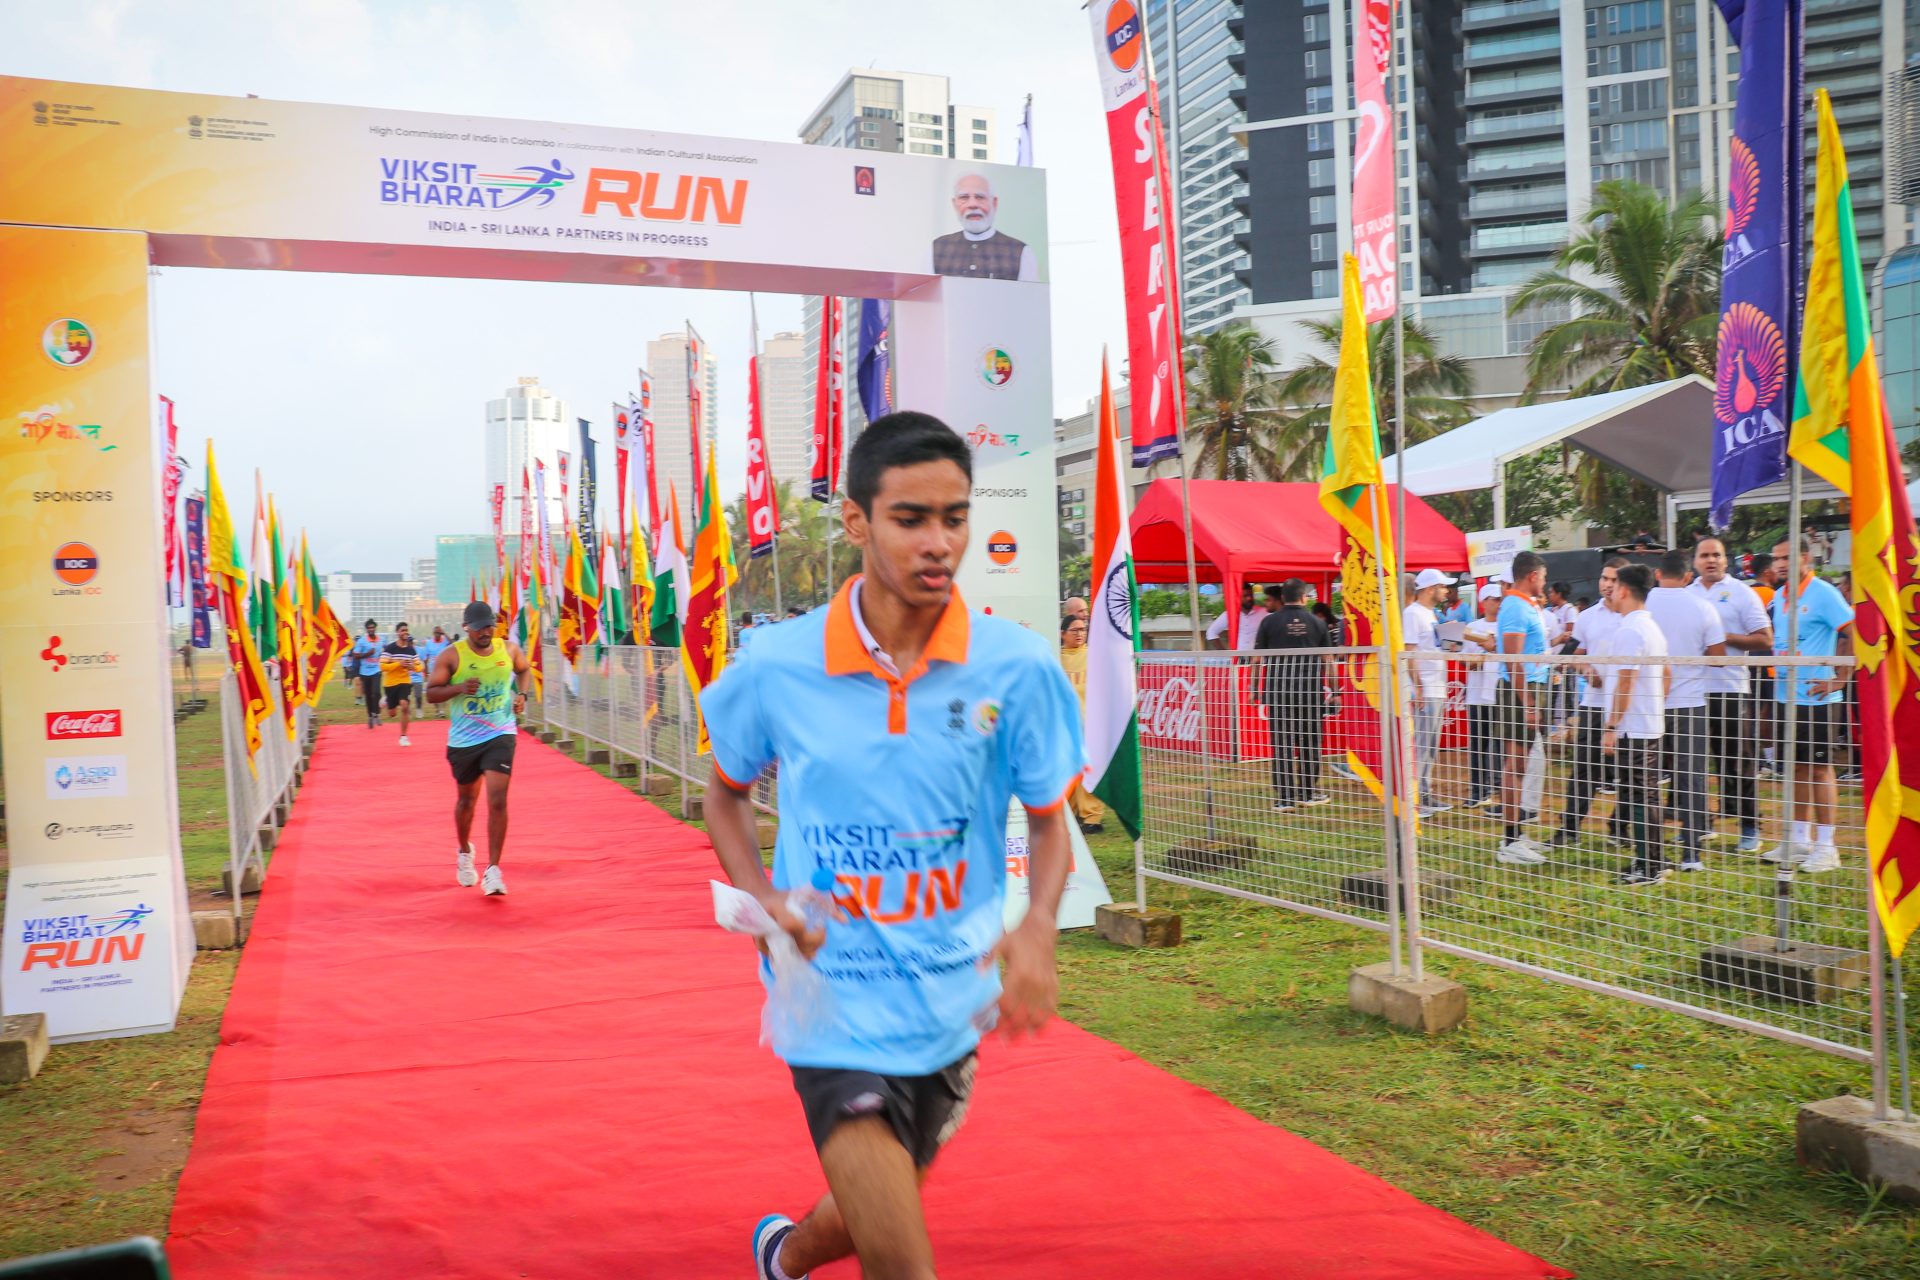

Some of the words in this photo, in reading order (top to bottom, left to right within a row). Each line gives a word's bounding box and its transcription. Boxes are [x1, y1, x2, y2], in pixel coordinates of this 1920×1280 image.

[1115, 24, 1133, 46] IOC
[369, 126, 393, 137] High
[395, 128, 459, 141] Commission
[460, 133, 471, 142] of
[472, 134, 498, 143] India
[499, 136, 509, 144] in
[511, 136, 555, 148] Colombo
[567, 142, 618, 153] collaboration
[637, 147, 665, 157] Indian
[667, 149, 704, 160] Cultural
[706, 153, 758, 164] Association
[380, 158, 478, 185] VIKSIT
[380, 181, 503, 209] BHARAT
[581, 167, 749, 226] RUN
[428, 220, 467, 232] INDIA
[481, 223, 502, 234] SRI
[505, 224, 550, 237] LANKA
[556, 227, 623, 242] PARTNERS
[626, 232, 640, 243] IN
[642, 233, 709, 247] PROGRESS
[1722, 233, 1755, 272] CA
[1721, 409, 1786, 455] ICA
[33, 491, 114, 503] SPONSORS
[974, 488, 1028, 498] SPONSORS
[994, 544, 1011, 552] IOC
[64, 559, 89, 569] IOC
[53, 587, 81, 596] Lanka
[815, 849, 920, 872] HARAT
[22, 925, 105, 943] BHARAT
[23, 915, 89, 931] VIKSIT
[20, 933, 146, 972] RUN
